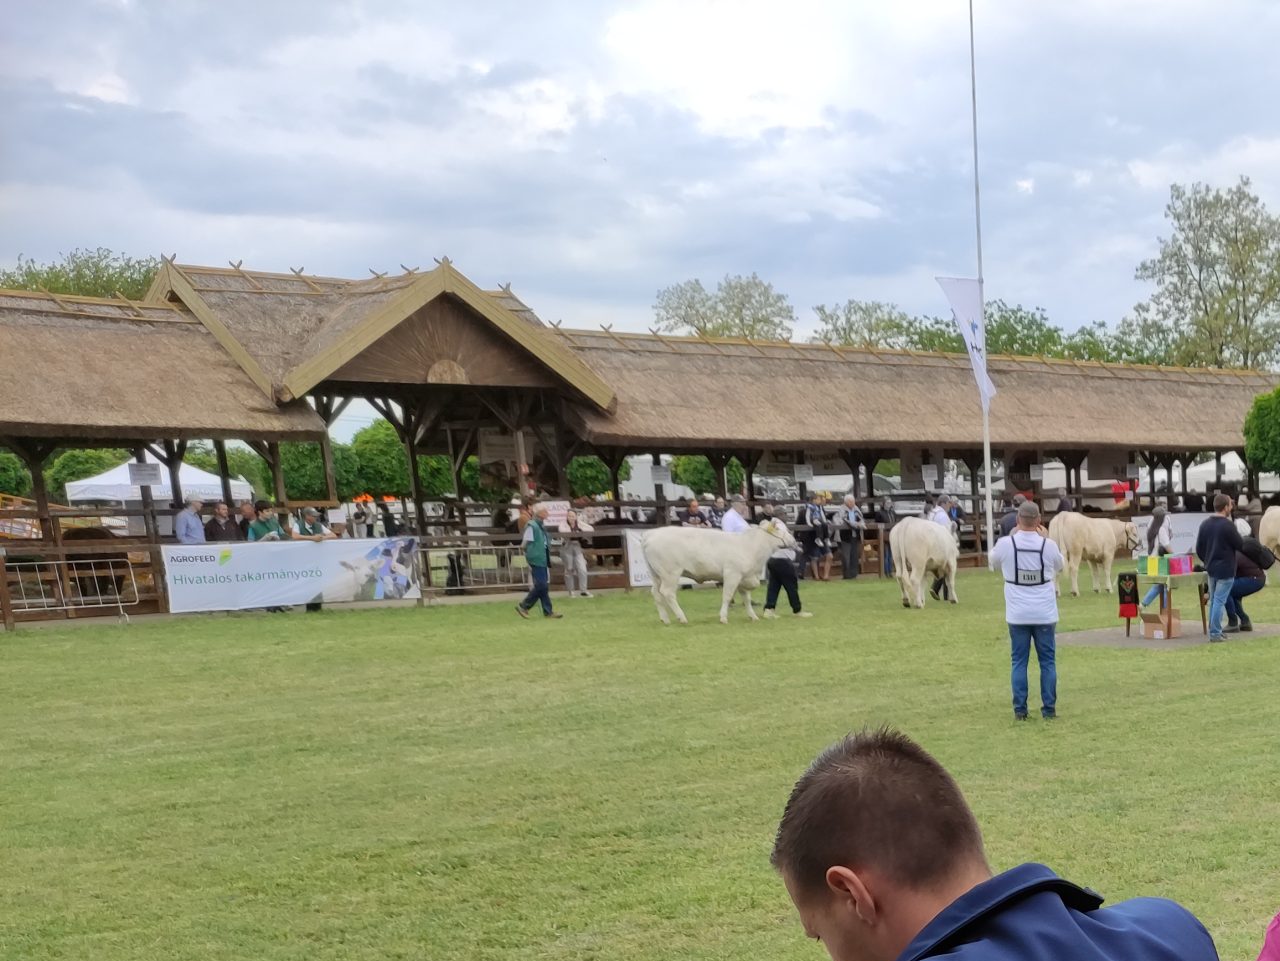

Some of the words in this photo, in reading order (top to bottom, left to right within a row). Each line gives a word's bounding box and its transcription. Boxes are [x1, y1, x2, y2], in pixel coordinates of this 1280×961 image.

[170, 554, 216, 563] AGROFEED
[173, 571, 233, 586] Hivatalos
[235, 567, 323, 583] takarmányozó
